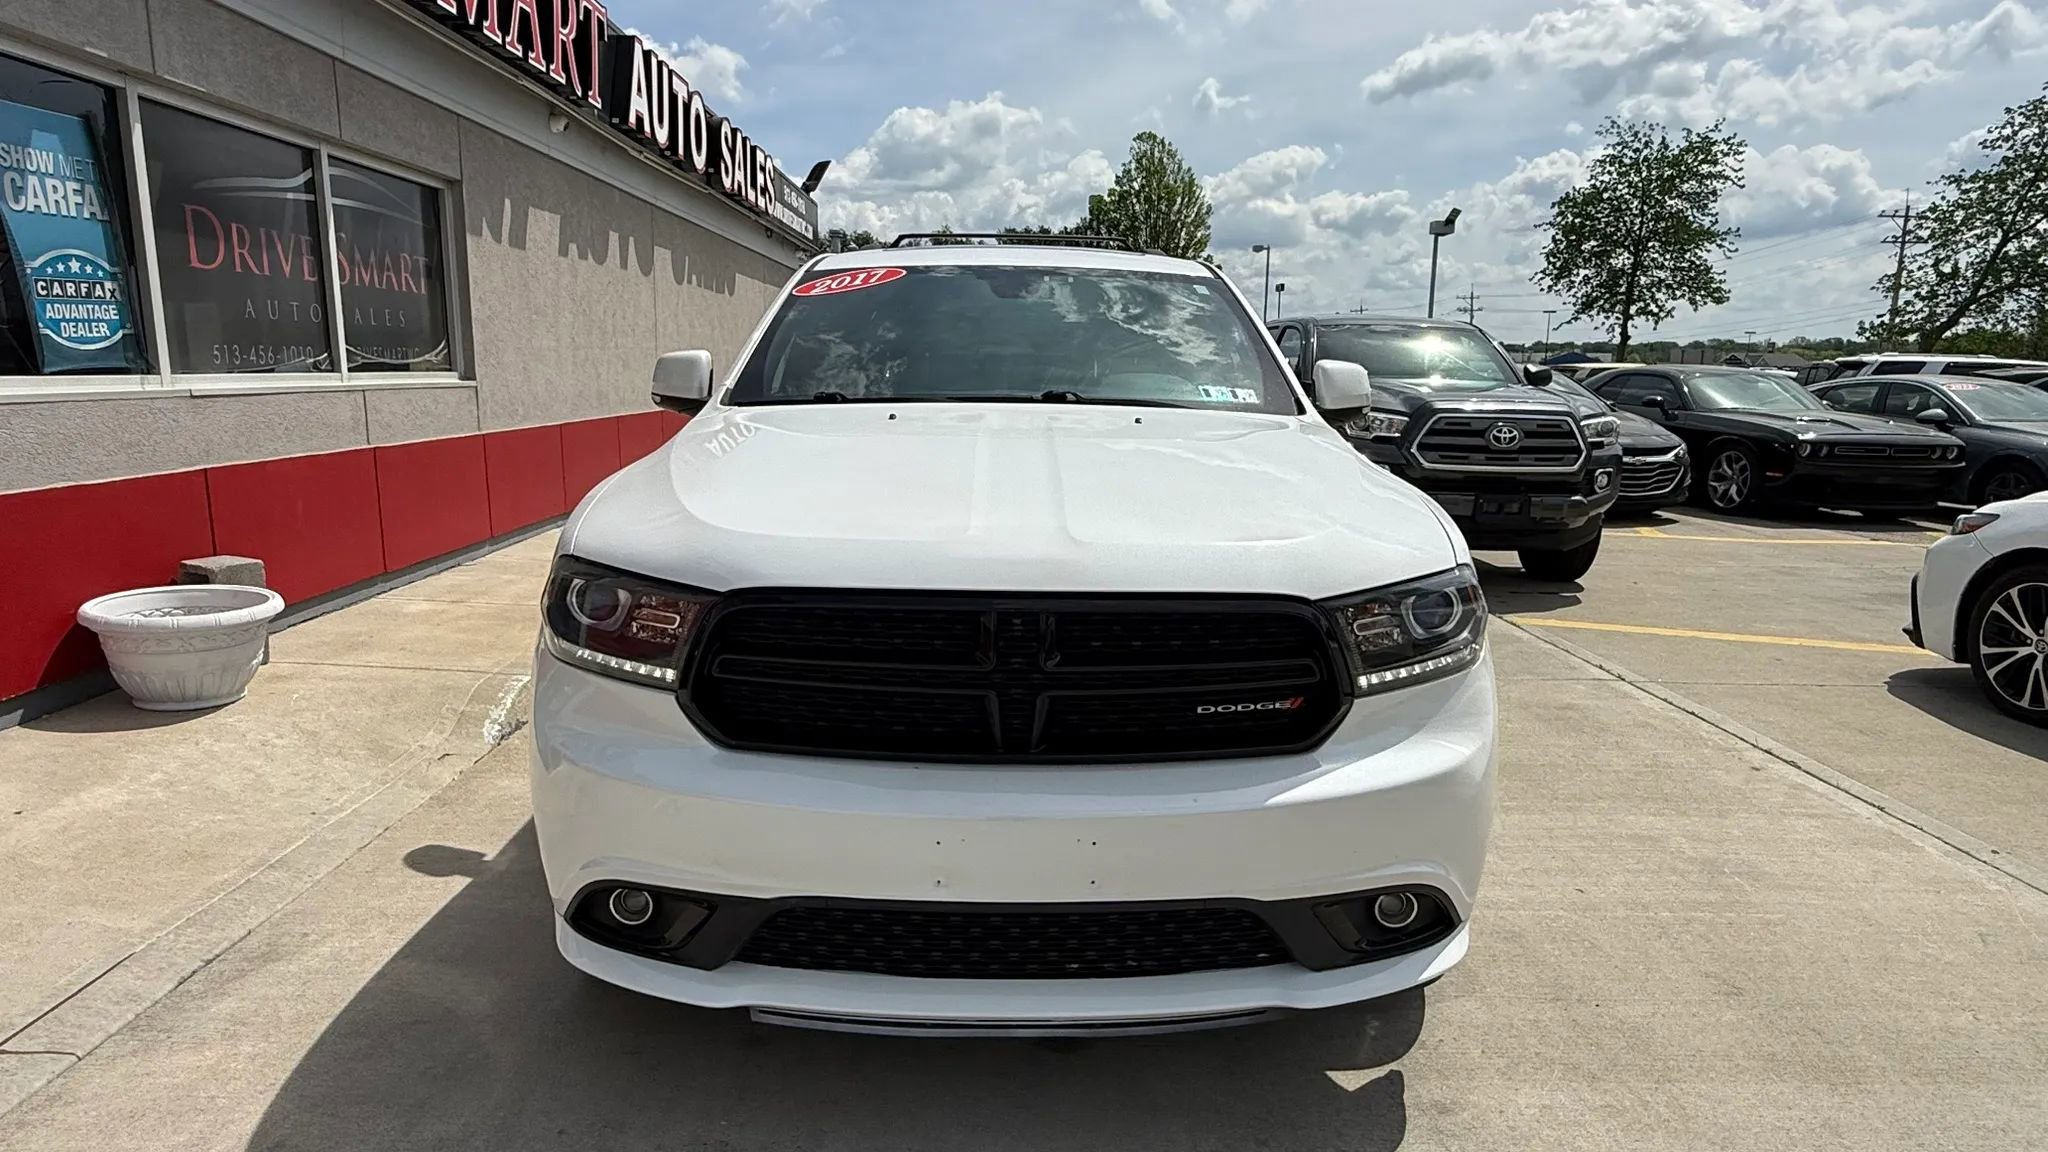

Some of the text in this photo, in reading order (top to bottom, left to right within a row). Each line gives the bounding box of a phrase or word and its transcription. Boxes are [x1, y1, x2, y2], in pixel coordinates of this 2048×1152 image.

[436, 0, 775, 215] ART AUTO SALES
[0, 142, 54, 175] SHOW
[58, 153, 85, 180] ME
[3, 171, 110, 221] CARFA
[183, 203, 319, 283] DRIVE
[36, 280, 118, 300] CARFAX
[809, 269, 887, 295] 2017
[46, 303, 119, 320] ADVANTAGE
[245, 298, 406, 328] AUTO ALES
[60, 322, 110, 337] DEALER
[212, 344, 314, 366] 513-456-1010
[1197, 701, 1292, 714] DODGE
